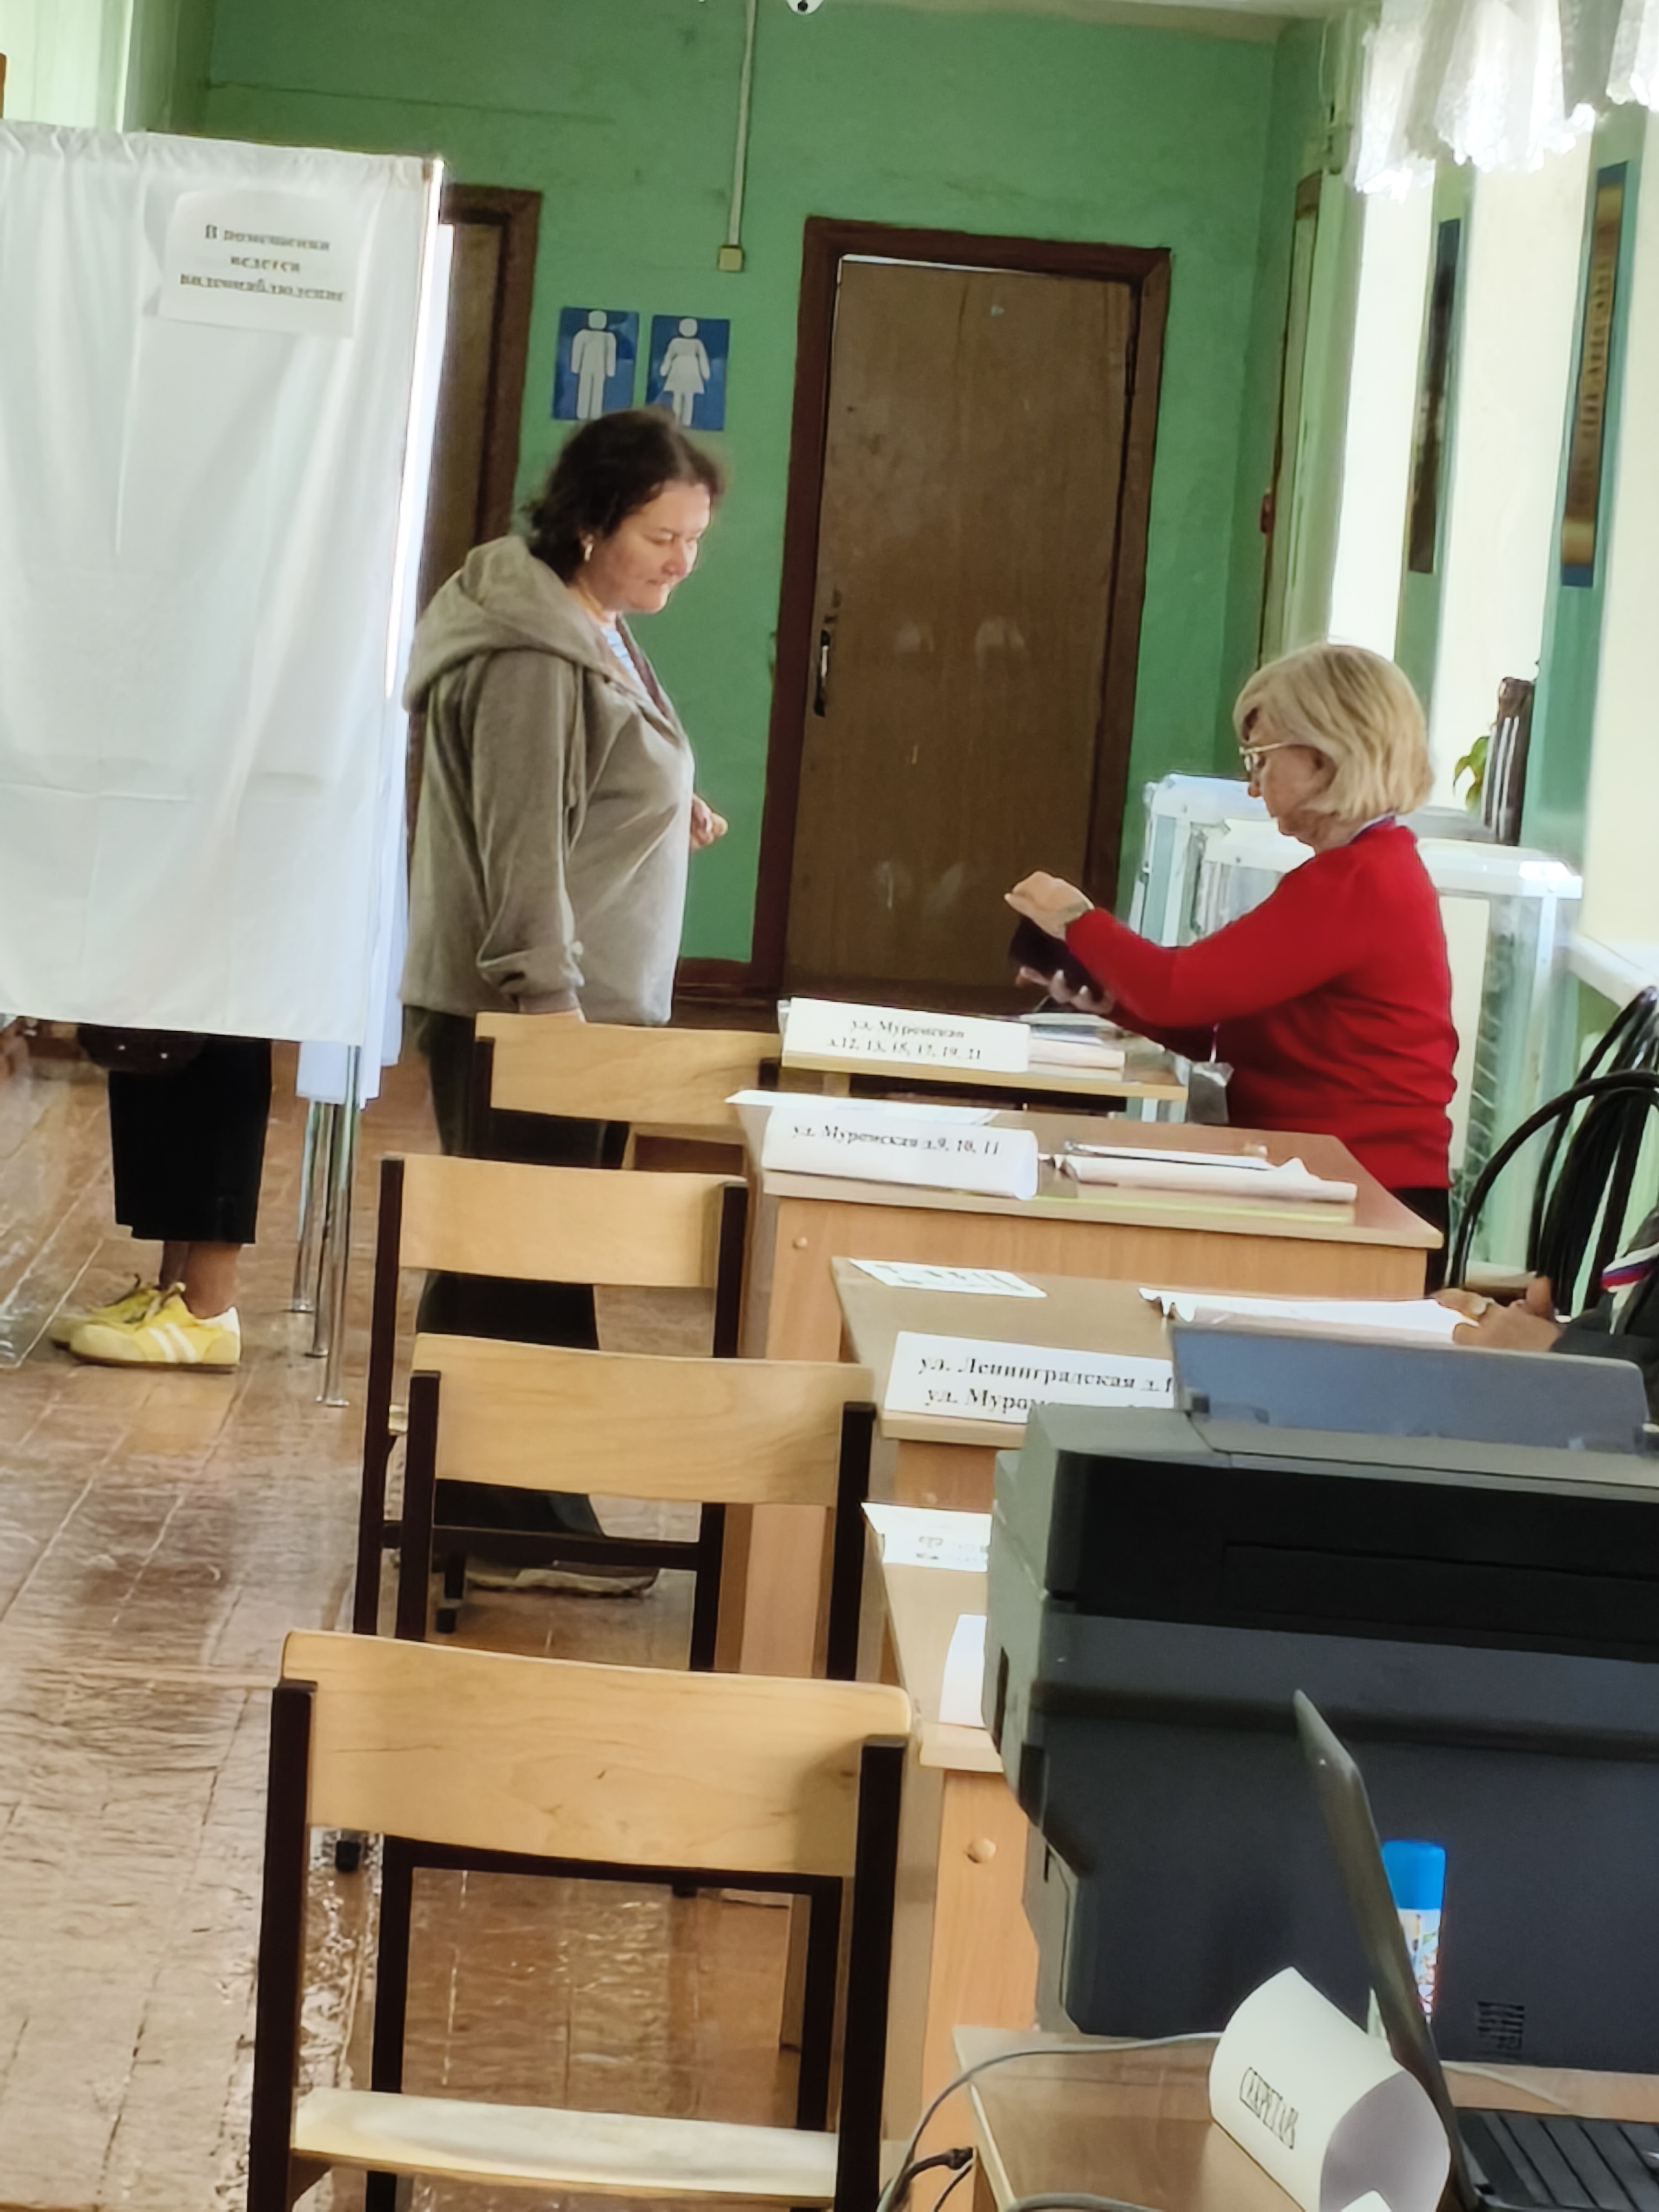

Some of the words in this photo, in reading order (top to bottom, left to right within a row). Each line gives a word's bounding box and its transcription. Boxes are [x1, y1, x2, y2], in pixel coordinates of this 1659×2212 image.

[918, 1358, 950, 1375] ул.
[957, 1356, 1135, 1388] Ленинградская
[925, 1389, 958, 1406] ул.
